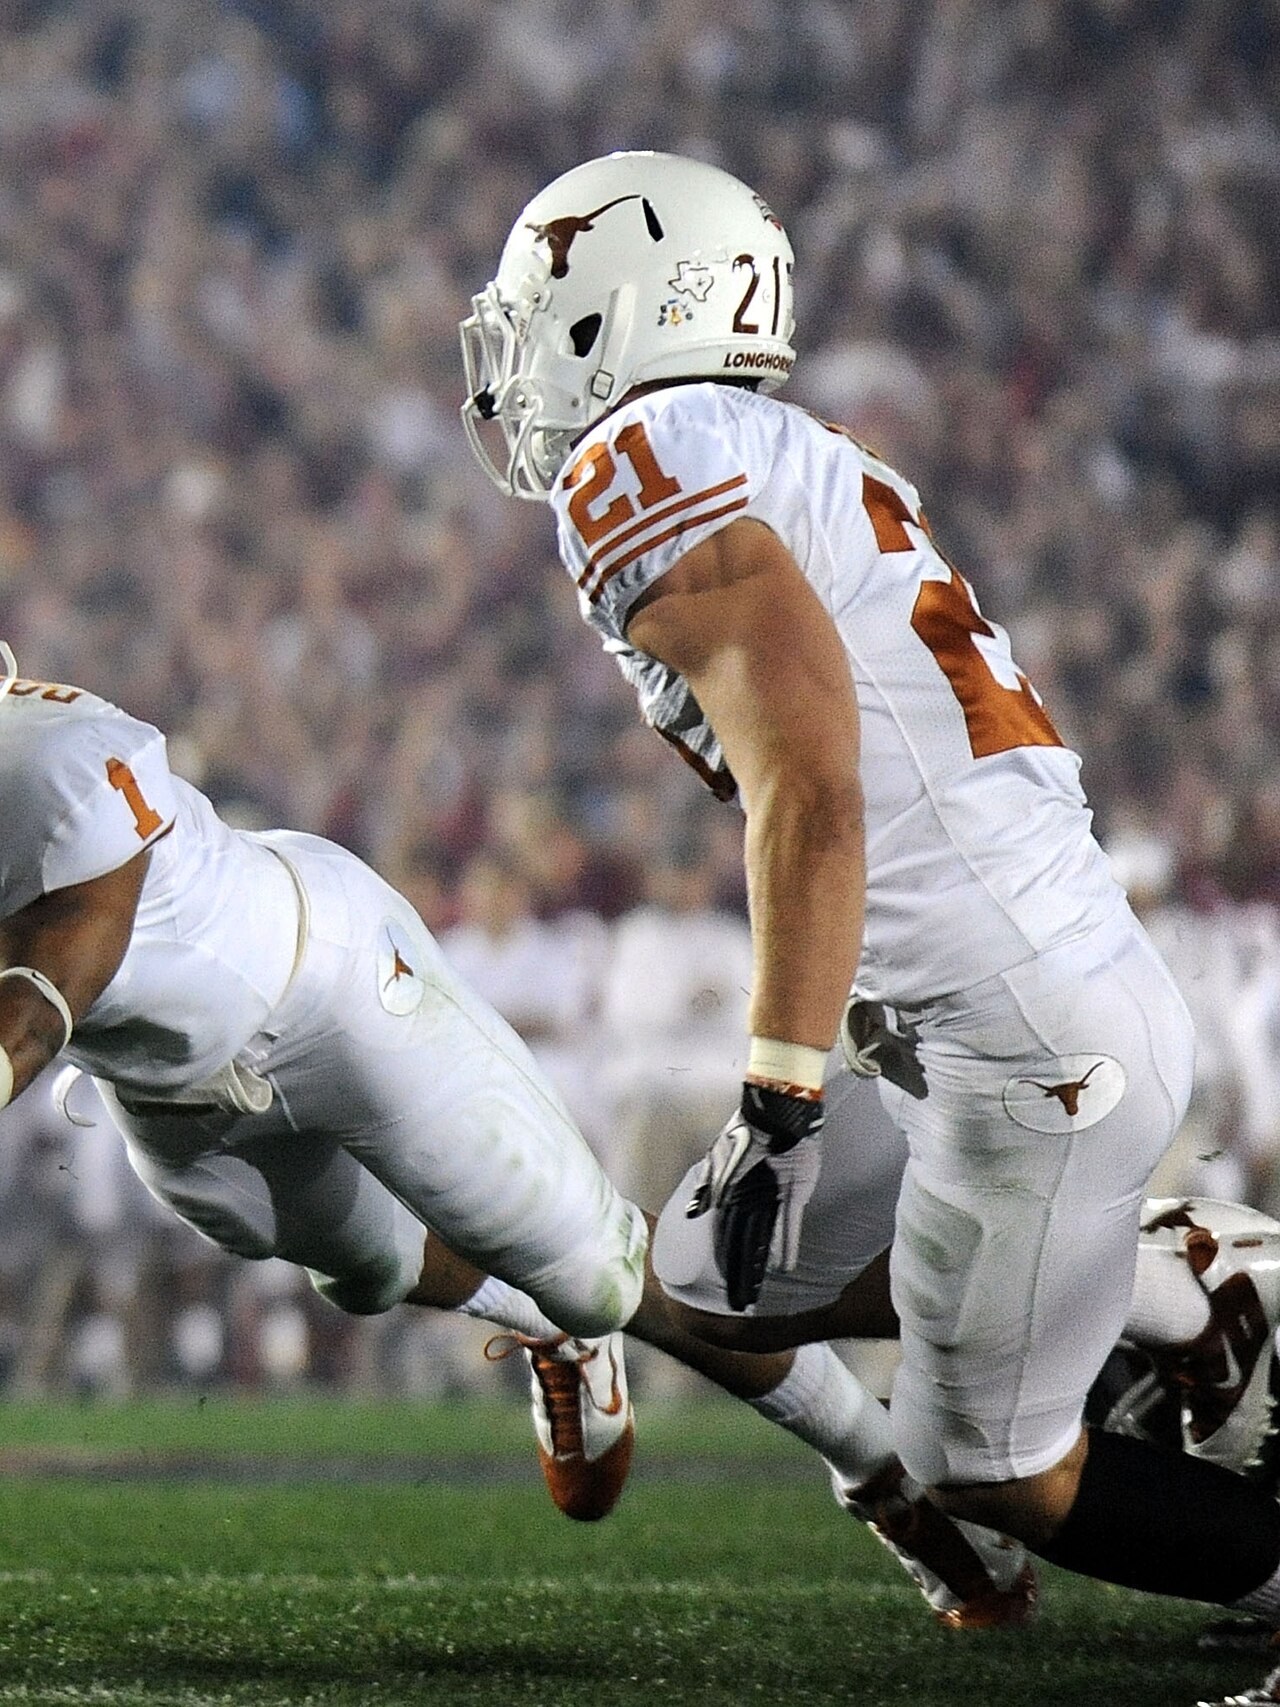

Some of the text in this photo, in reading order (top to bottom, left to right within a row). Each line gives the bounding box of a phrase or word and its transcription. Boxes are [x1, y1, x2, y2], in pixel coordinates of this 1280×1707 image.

[732, 254, 780, 336] 21
[562, 421, 683, 549] 21
[105, 757, 164, 841] 1
